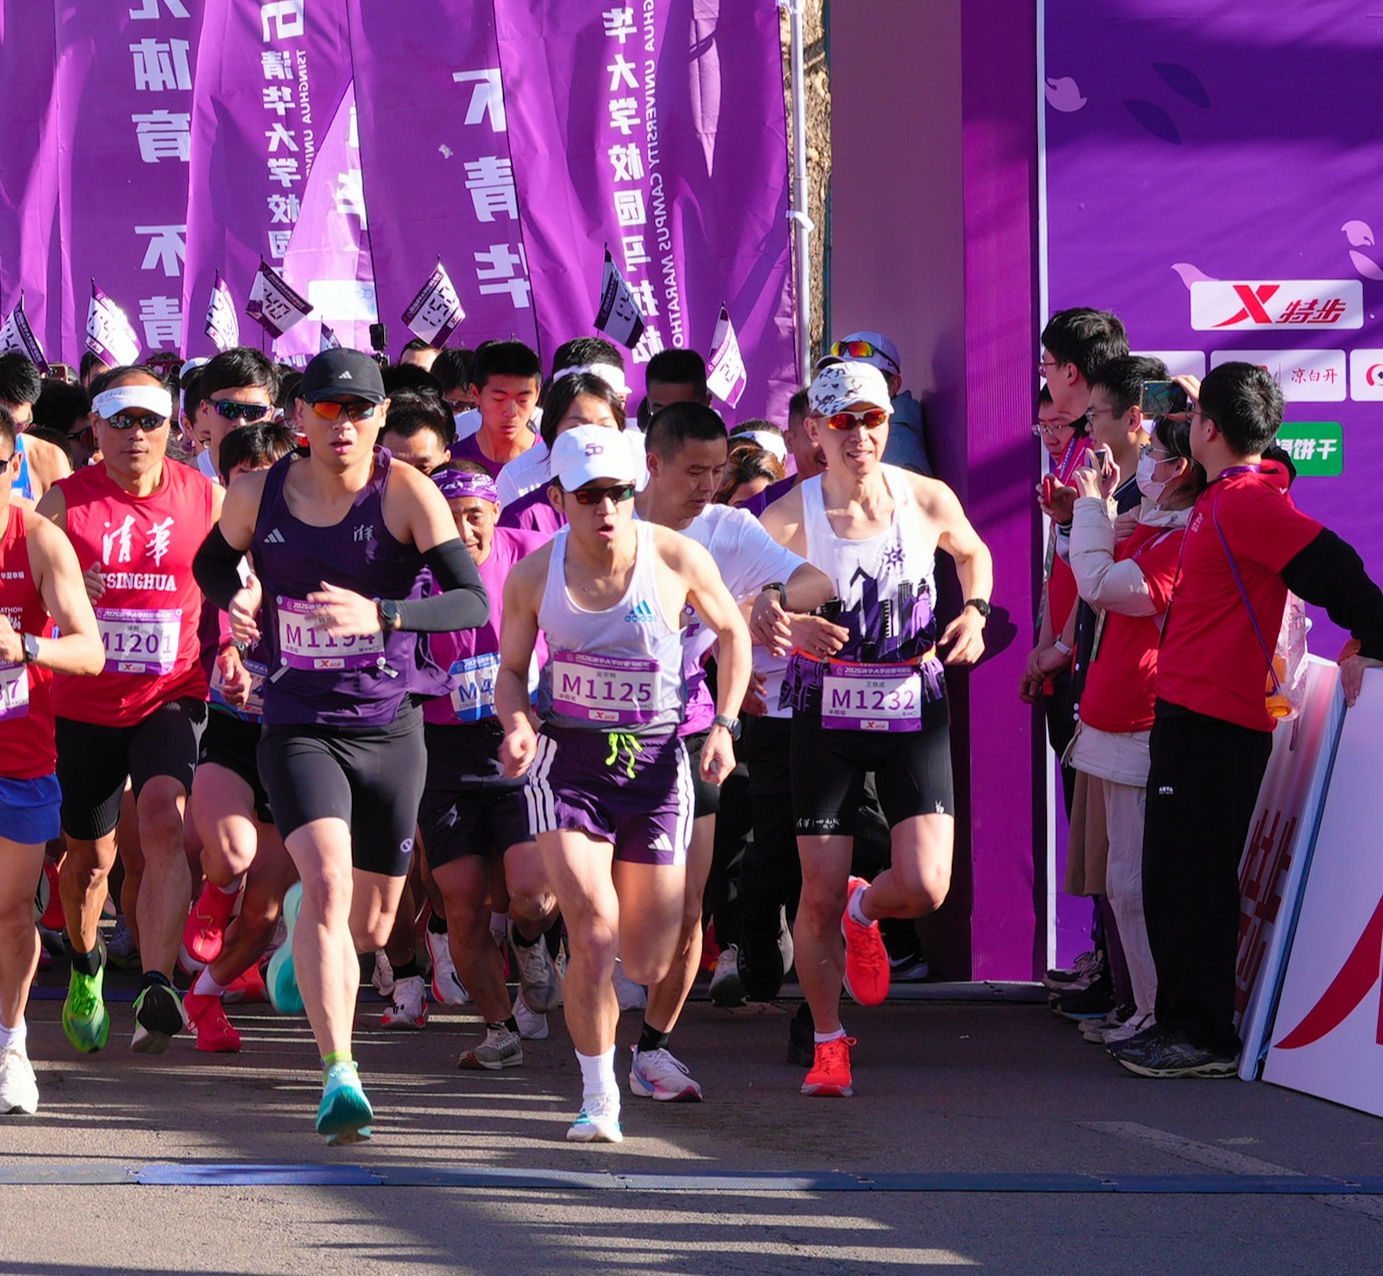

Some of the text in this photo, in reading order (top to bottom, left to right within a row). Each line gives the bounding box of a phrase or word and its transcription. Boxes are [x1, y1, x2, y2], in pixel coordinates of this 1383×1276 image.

[625, 613, 658, 624] adidas
[562, 672, 652, 701] M1125
[831, 688, 915, 711] M1232
